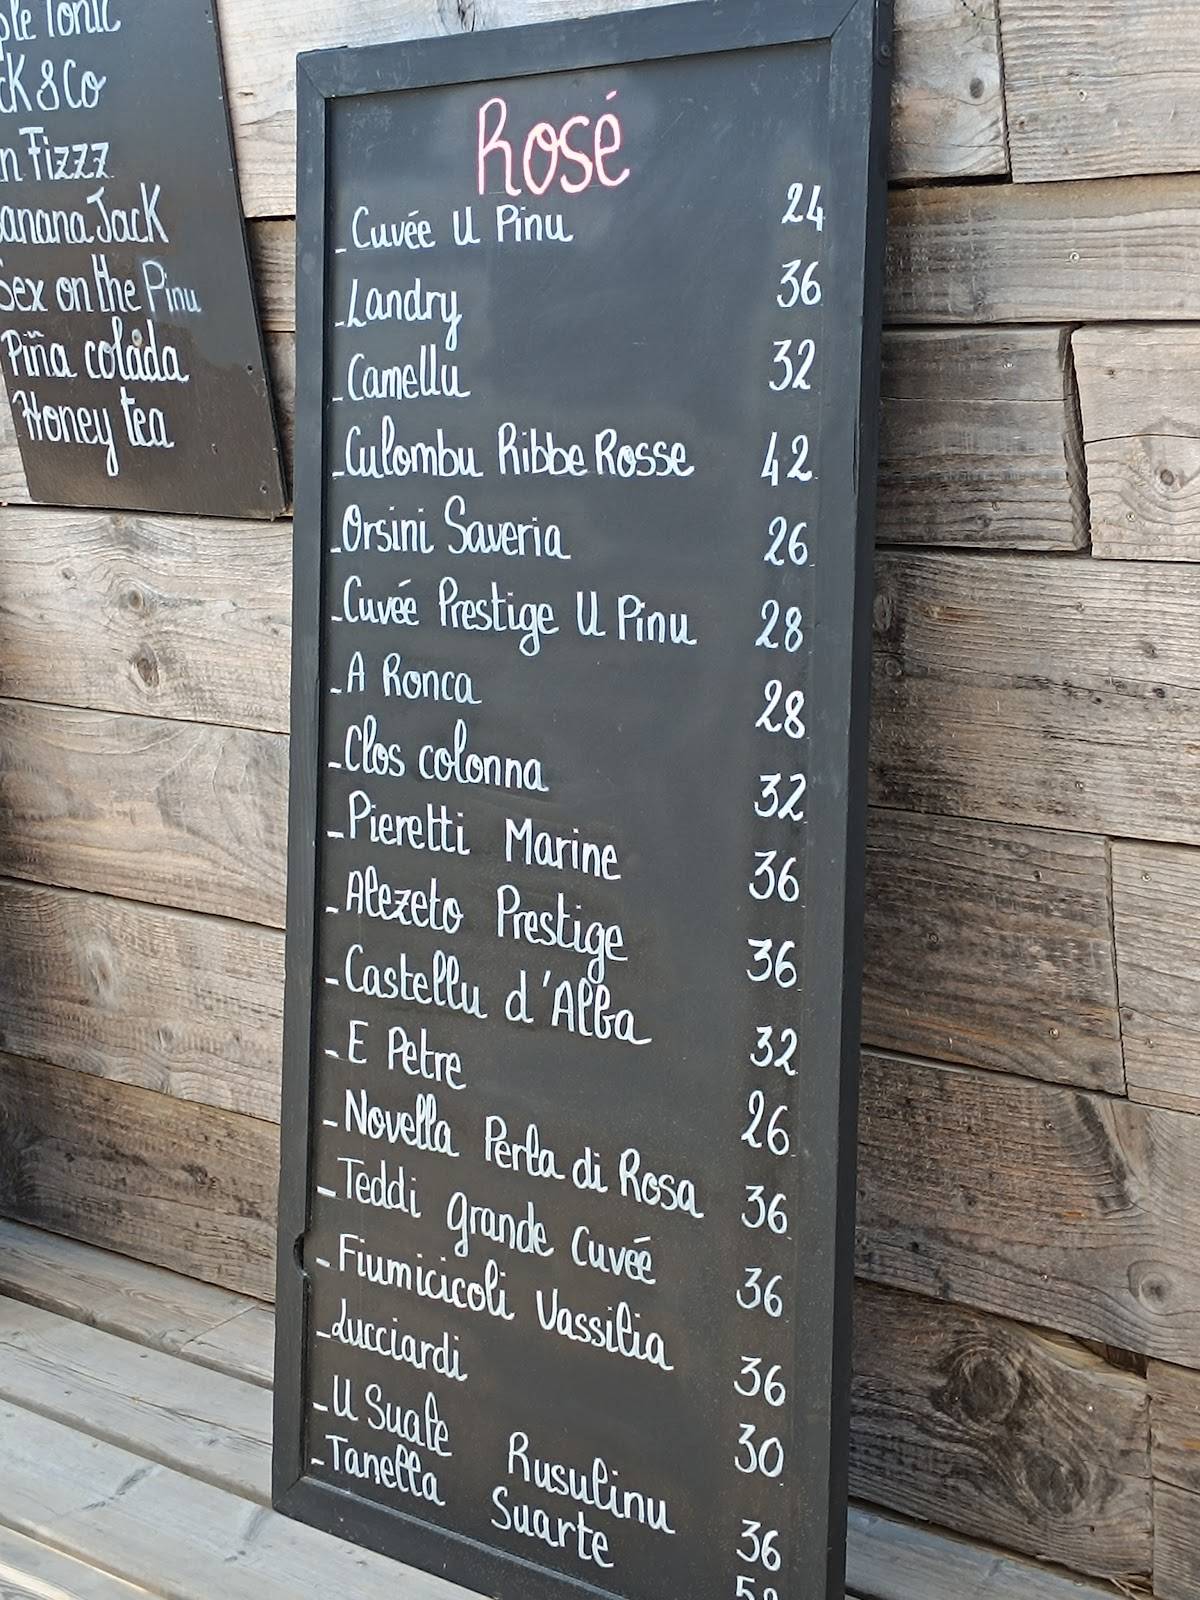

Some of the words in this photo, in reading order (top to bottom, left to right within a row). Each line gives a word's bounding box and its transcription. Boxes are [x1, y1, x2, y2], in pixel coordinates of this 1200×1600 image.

[478, 90, 631, 197] Rosé
[0, 205, 95, 245] anana
[351, 205, 436, 250] Cuvée
[452, 206, 481, 246] U
[496, 203, 574, 243] Pinu
[780, 182, 824, 232] 24
[55, 276, 95, 313] on
[90, 253, 142, 313] the
[141, 259, 202, 314] Pinu
[776, 258, 822, 308] 36
[346, 277, 463, 352] Landry
[1, 328, 77, 379] Piña
[347, 343, 471, 402] Camellu
[768, 338, 816, 392] 32
[119, 385, 175, 449] tea
[345, 414, 484, 479] Culombu
[497, 421, 589, 477] Ribbe
[594, 428, 695, 478] Rosse
[760, 431, 813, 487] 42
[342, 503, 435, 554] Orsini
[444, 494, 572, 560] Saveria
[763, 516, 808, 566] 26
[343, 575, 420, 626] Cuvée
[438, 576, 560, 657] Prestige
[576, 590, 607, 637] U
[617, 594, 698, 646] Pinu
[754, 599, 804, 653] 28
[346, 650, 365, 694] A
[382, 652, 483, 705] Ronca
[754, 679, 806, 740] 28
[344, 714, 406, 777] Clos
[753, 772, 807, 822] 32
[348, 789, 471, 856] Pieretti
[505, 817, 622, 881] Marine
[748, 849, 800, 903] 36
[496, 884, 629, 988] Prestige
[745, 938, 797, 989] 36
[344, 943, 488, 1019] Castellu
[348, 1019, 369, 1065] E
[387, 1026, 467, 1091] Petre
[749, 1025, 799, 1077] 32
[740, 1089, 790, 1156] 26
[345, 1088, 460, 1158] Novella
[484, 1115, 566, 1180] Perla
[572, 1146, 609, 1194] di
[618, 1147, 705, 1219] Rosa
[336, 1156, 422, 1219] Teddi
[571, 1225, 657, 1285] Cuvée
[741, 1184, 788, 1235] 36
[339, 1233, 516, 1323] Fiumicicoli
[535, 1287, 675, 1371] Vassilia
[735, 1267, 783, 1318] 36
[733, 1355, 786, 1407] 36
[333, 1374, 359, 1422] U
[508, 1431, 676, 1537] Rusulinu
[734, 1422, 785, 1478] 30
[324, 1433, 446, 1507] Tanella
[490, 1485, 615, 1568] Suarte
[735, 1518, 782, 1572] 36
